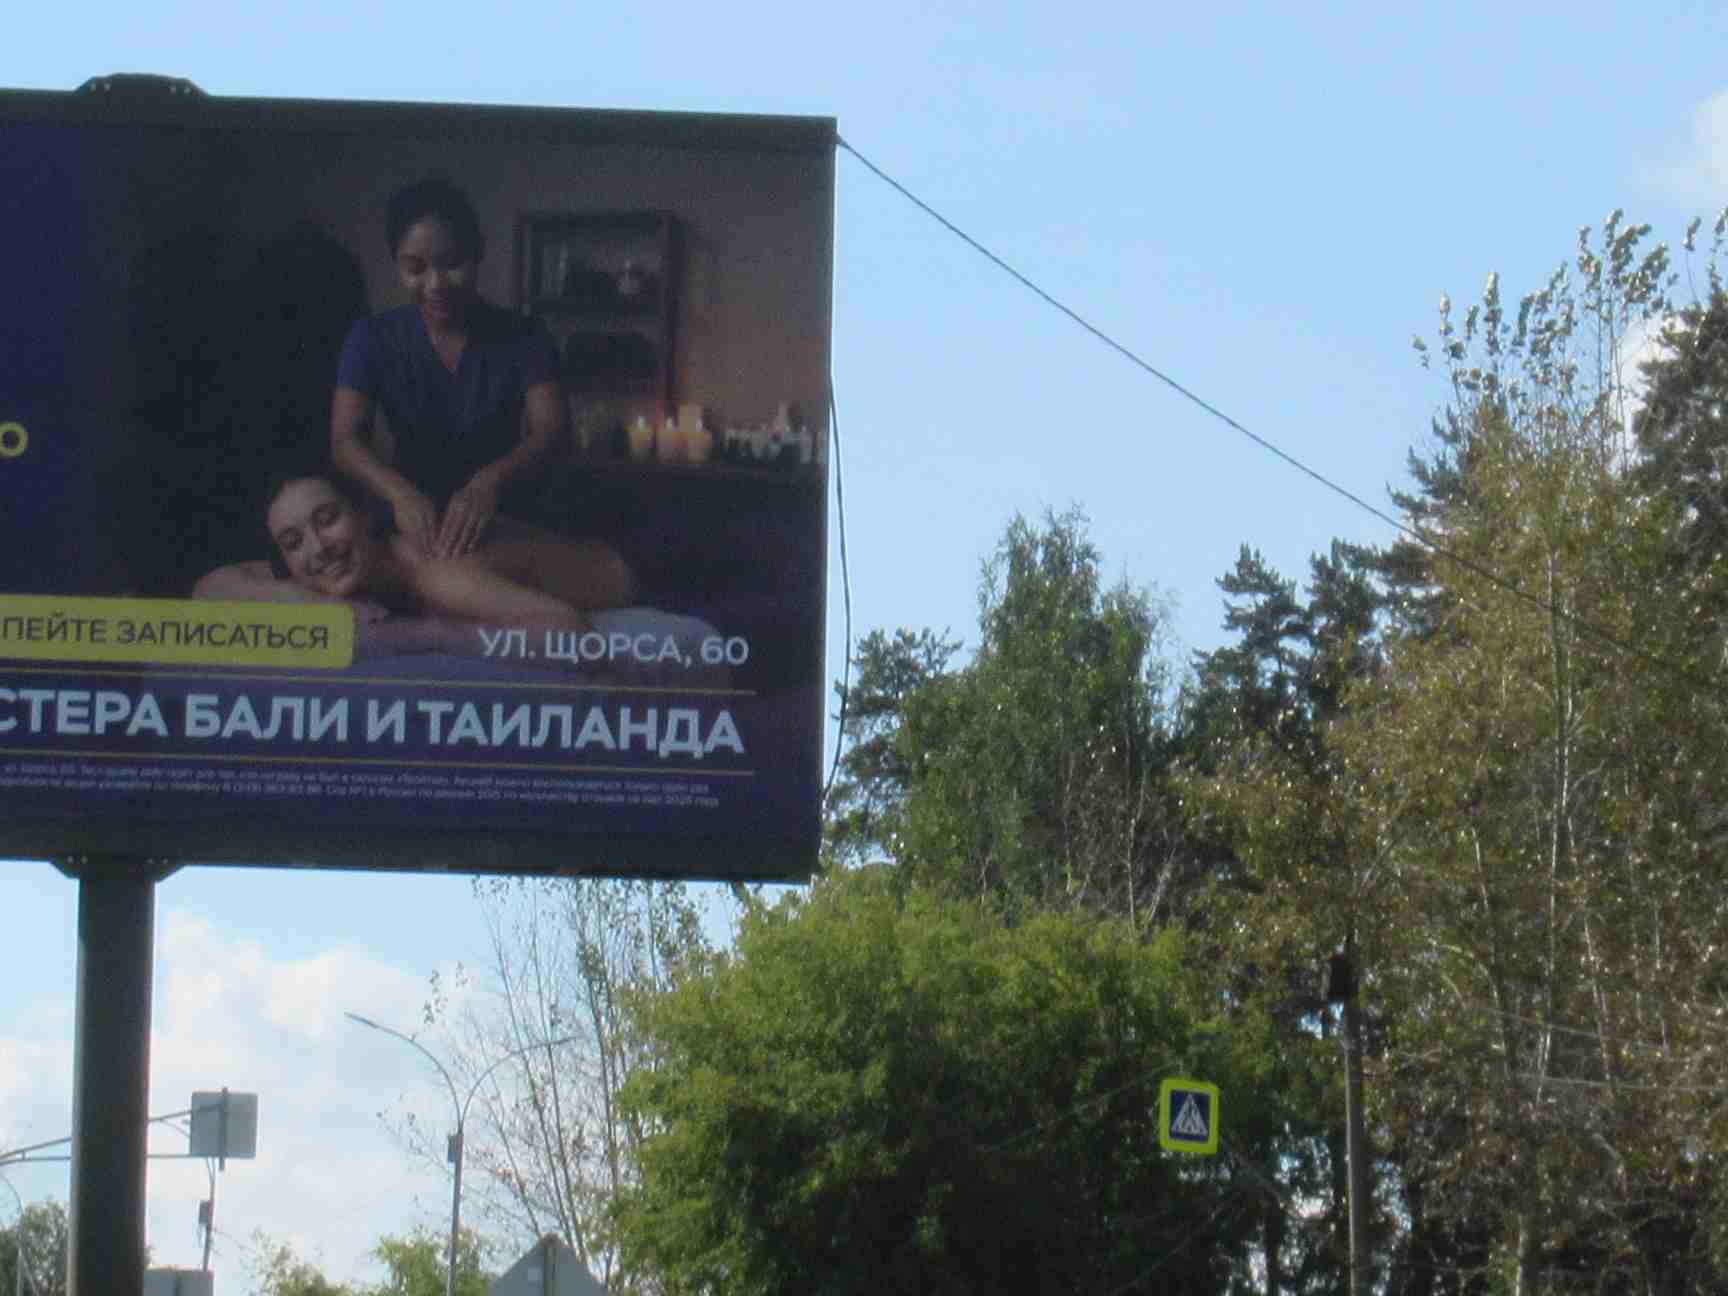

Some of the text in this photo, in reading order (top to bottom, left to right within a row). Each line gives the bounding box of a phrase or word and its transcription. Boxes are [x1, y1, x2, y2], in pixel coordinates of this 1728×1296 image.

[116, 619, 330, 650] ЗАПИСАТЬСЯ
[478, 628, 750, 669] УЛ. ЩОРСА, 60
[185, 693, 350, 741] БАЛИ
[367, 699, 406, 743] И
[417, 700, 746, 759] ТАИЛАНДА
